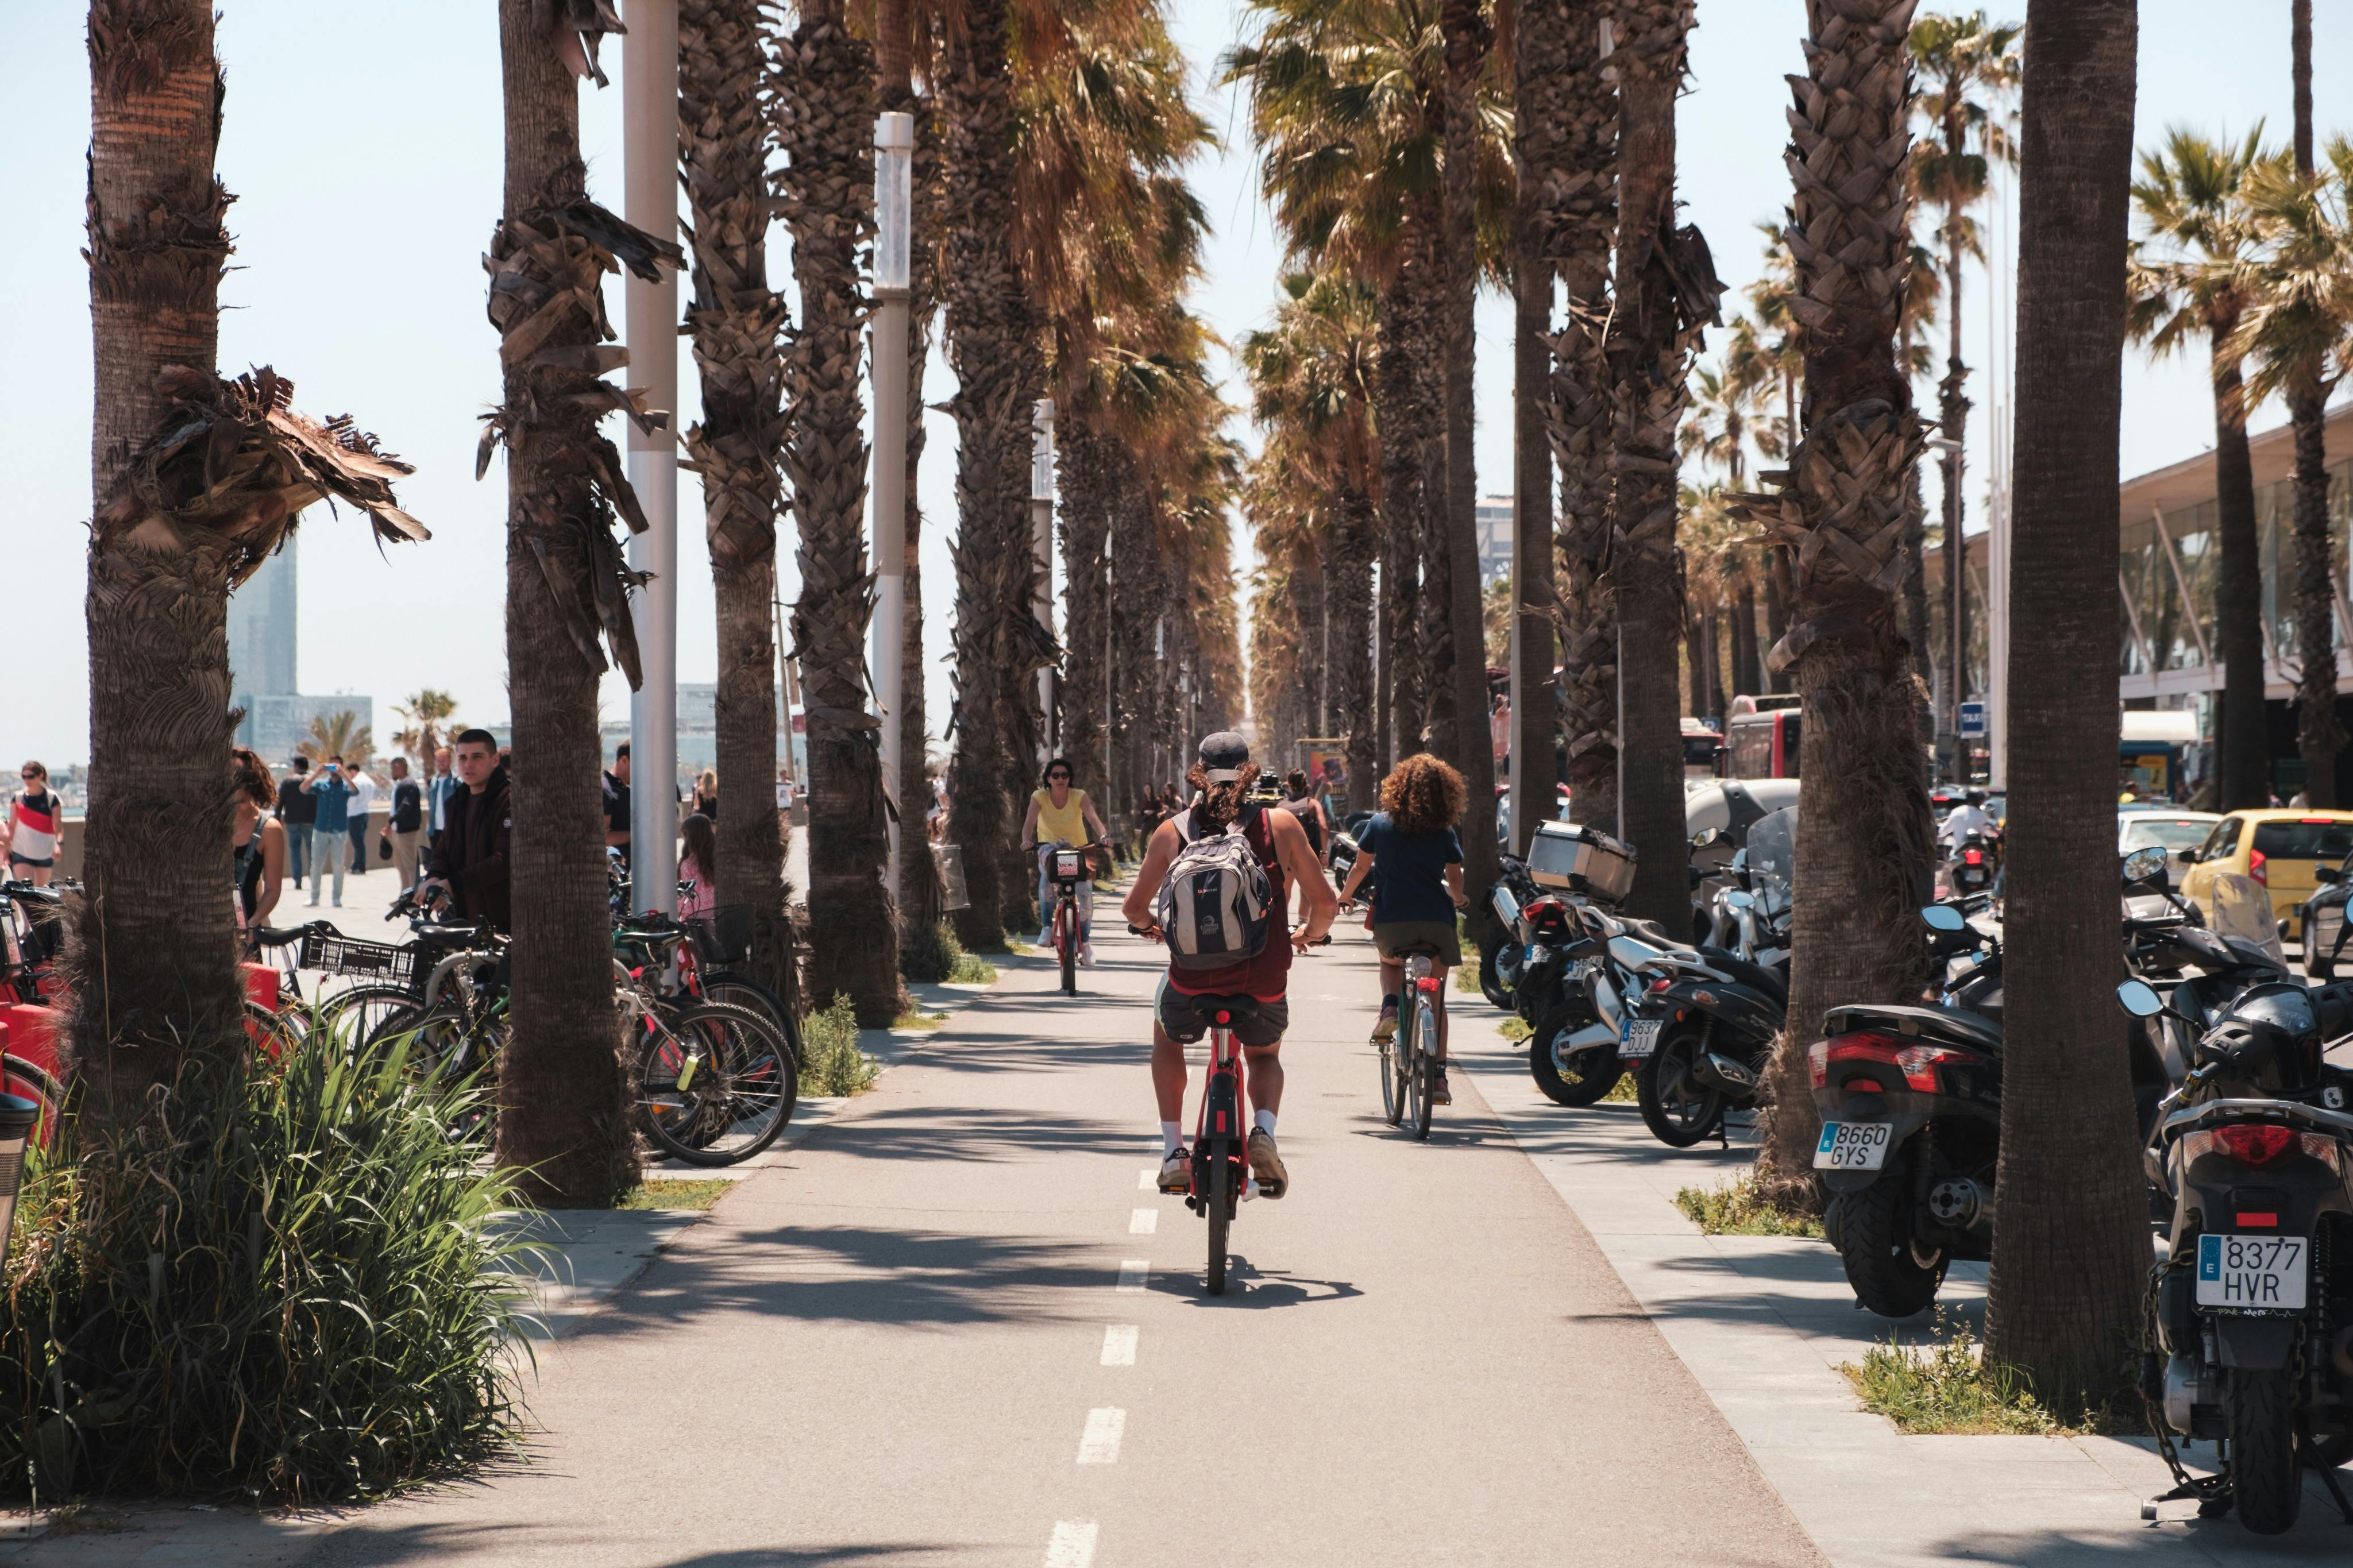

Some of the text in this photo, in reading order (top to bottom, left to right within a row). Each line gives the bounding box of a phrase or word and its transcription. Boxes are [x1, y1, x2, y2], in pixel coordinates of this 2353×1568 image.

[1962, 713, 1983, 723] TAXI
[1631, 1021, 1660, 1035] 9637
[1627, 1036, 1649, 1051] DJJ
[1837, 1126, 1887, 1146] 8660
[1831, 1146, 1869, 1165] GYS
[2227, 1242, 2301, 1270] 8377
[2206, 1263, 2214, 1273] E
[2225, 1272, 2279, 1302] HVR
